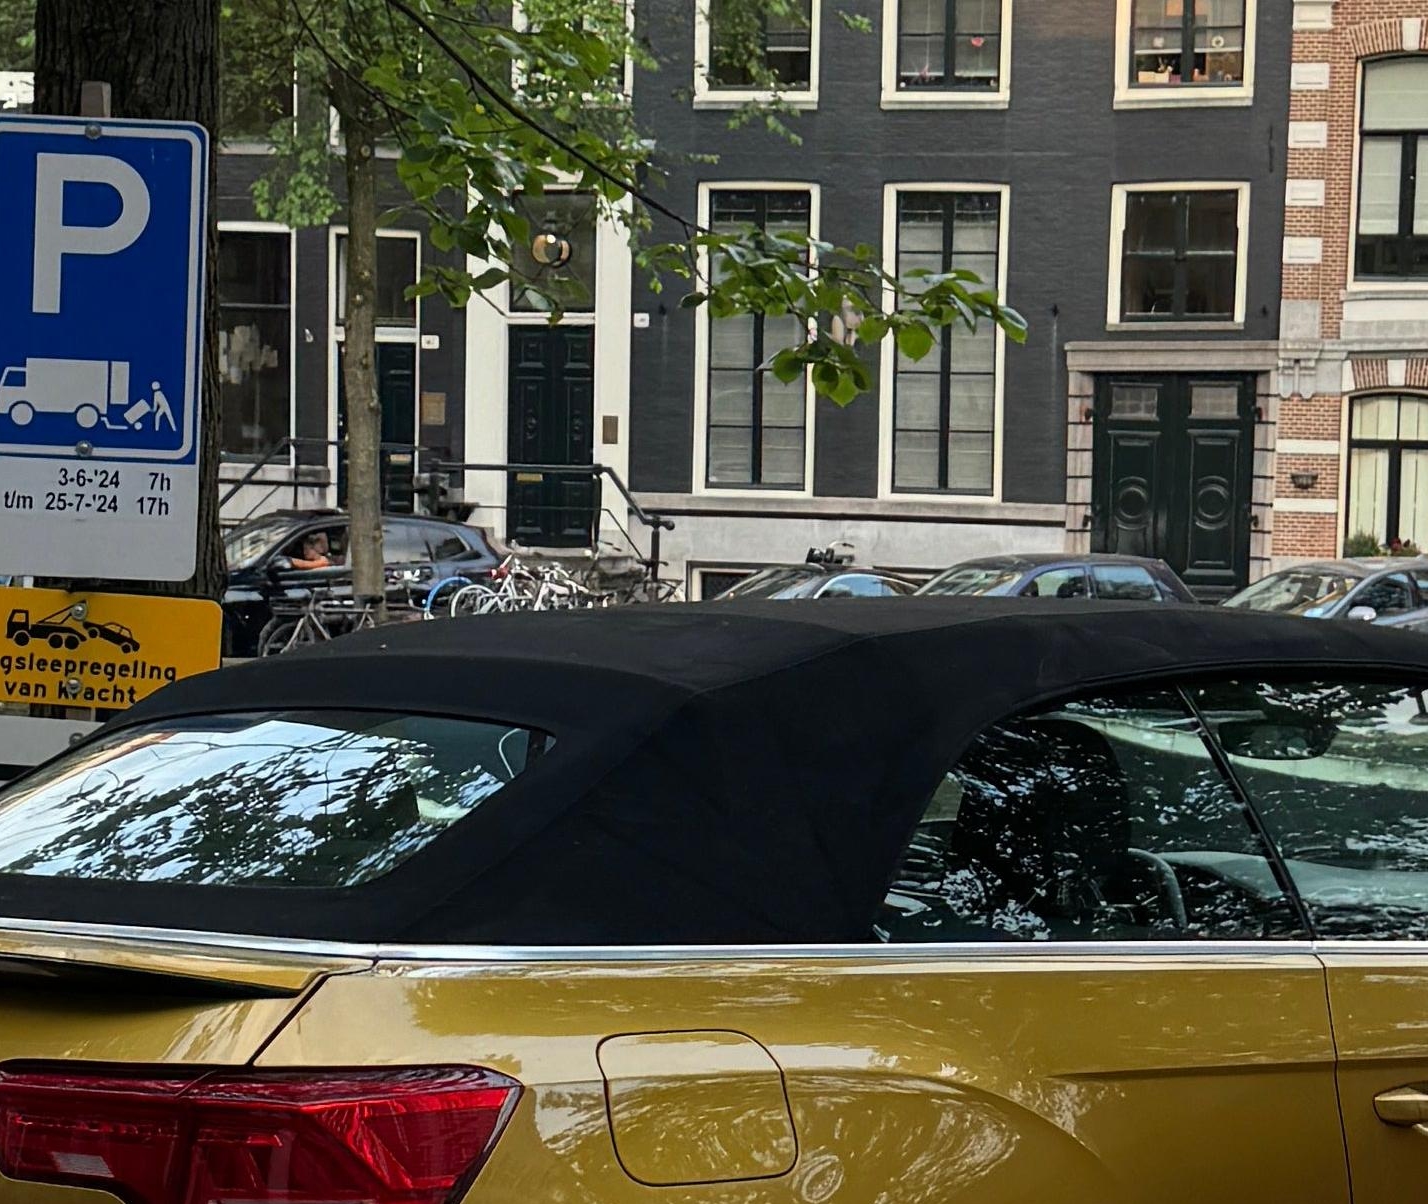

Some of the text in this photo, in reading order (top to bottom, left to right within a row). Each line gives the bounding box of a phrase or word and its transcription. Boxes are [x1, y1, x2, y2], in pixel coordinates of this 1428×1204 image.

[32, 152, 151, 314] P
[58, 468, 171, 492] 3-6-'24 7h
[4, 490, 170, 516] t/m 25-7-'24 17h
[4, 680, 47, 698] van
